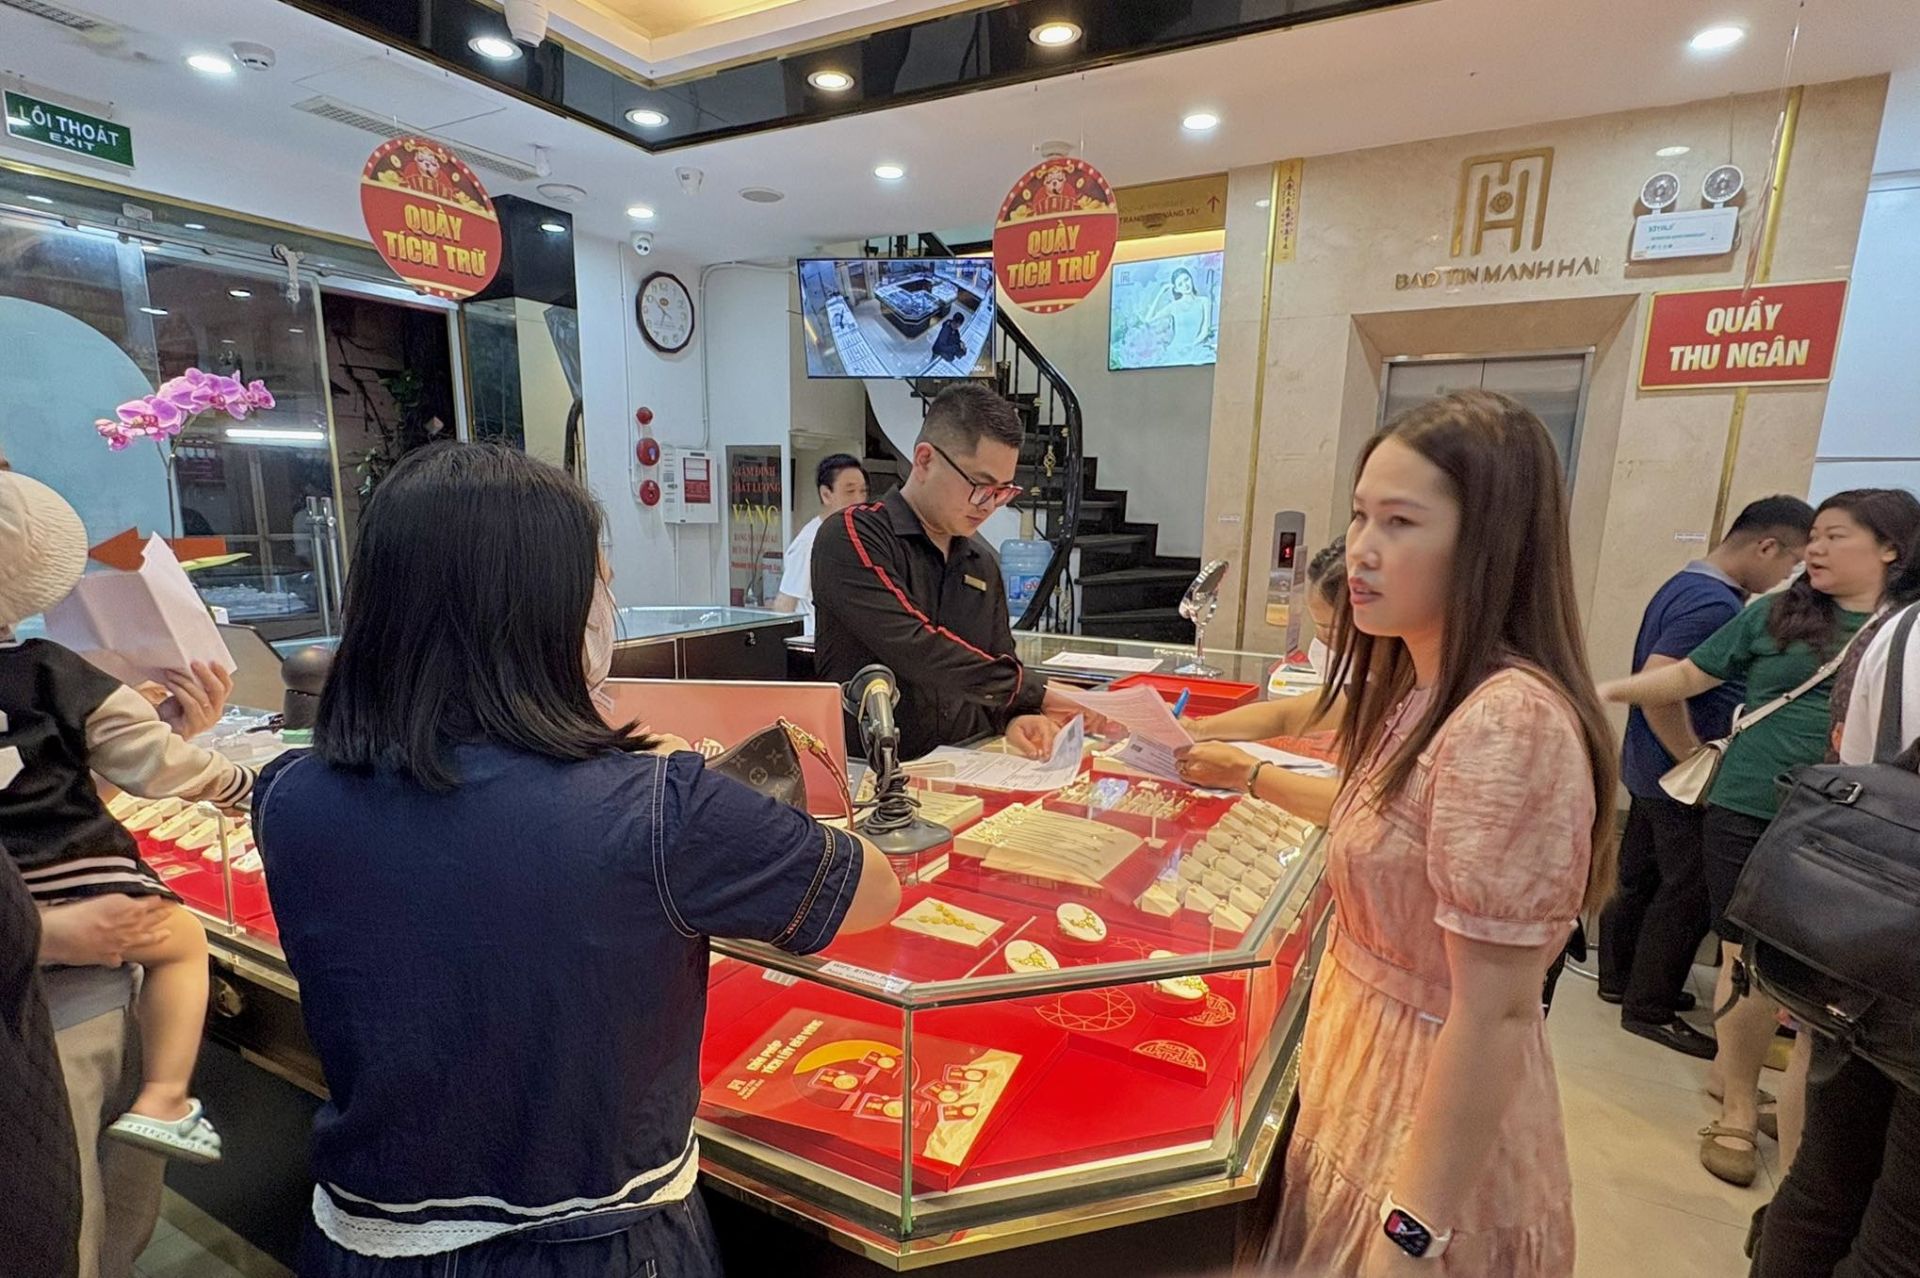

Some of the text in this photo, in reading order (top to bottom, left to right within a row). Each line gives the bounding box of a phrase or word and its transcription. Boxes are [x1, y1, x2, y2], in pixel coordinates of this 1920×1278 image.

[49, 132, 95, 151] EXIT
[55, 115, 119, 147] THOÁT
[404, 203, 462, 242] QUẦY
[1027, 219, 1080, 258] QUẦY
[382, 230, 439, 268] TÍCH
[442, 245, 487, 277] TRỮ
[1006, 259, 1052, 290] TÍCH
[1057, 250, 1100, 283] TRỮ
[1705, 296, 1783, 337] QUẦY
[1669, 343, 1721, 372] THU
[1725, 335, 1810, 369] NGÂN
[732, 498, 779, 526] VÀNG
